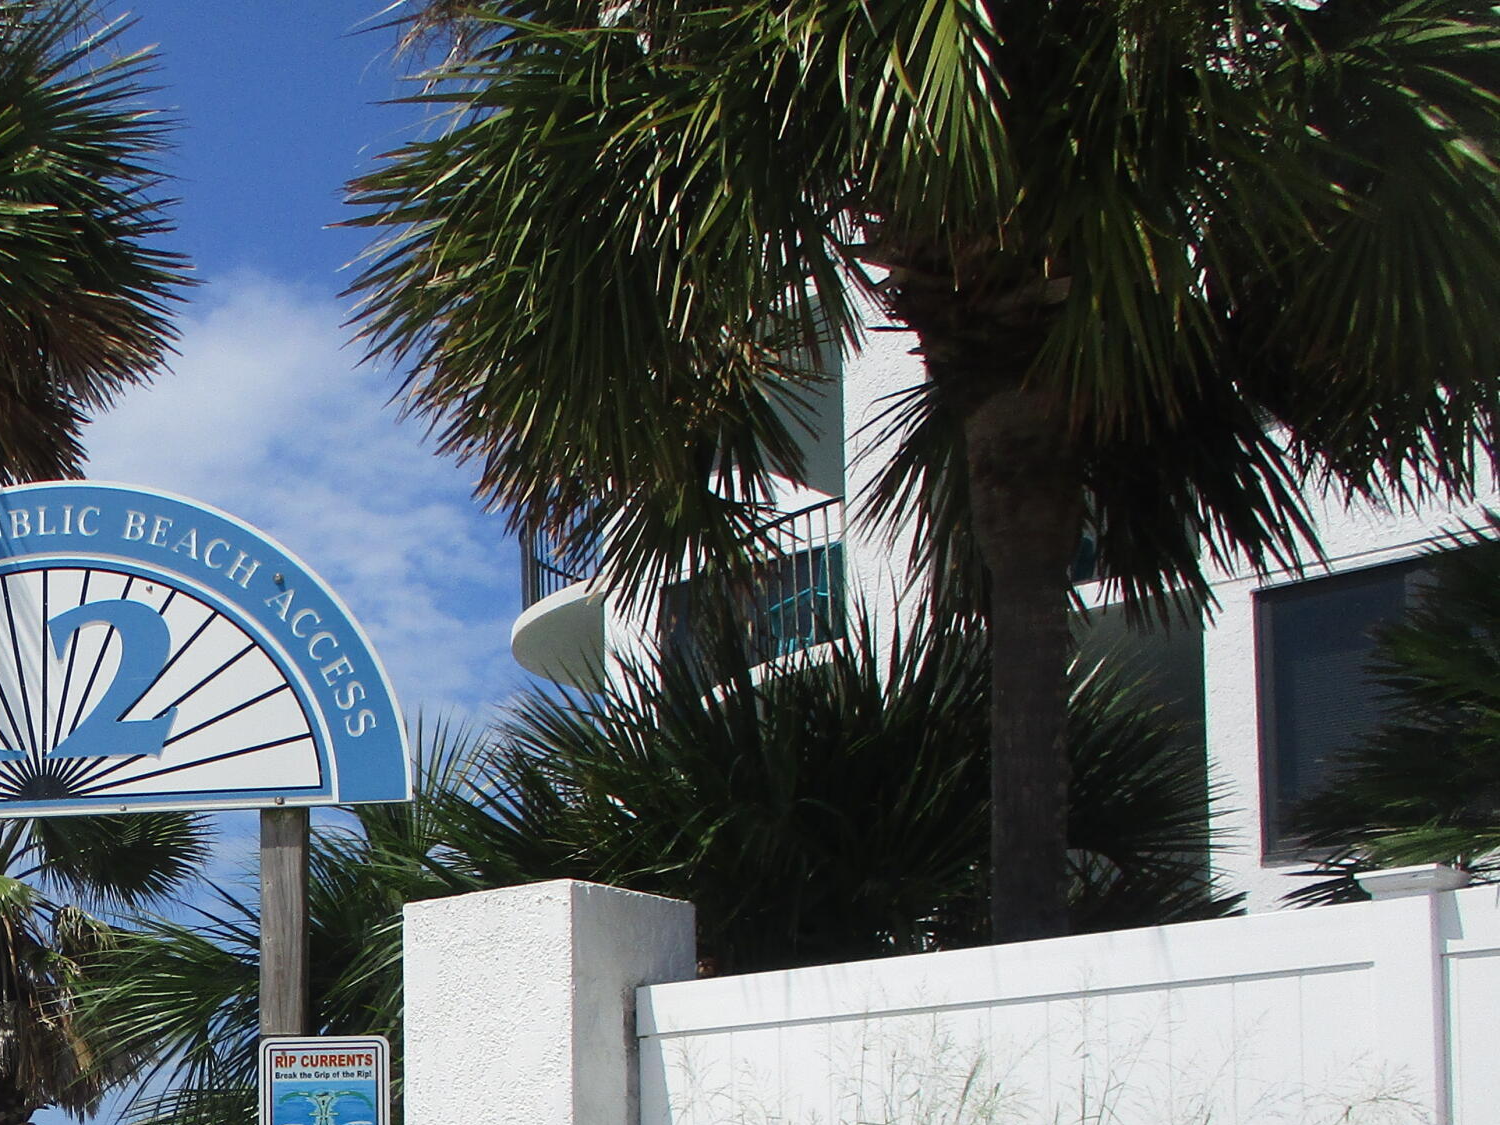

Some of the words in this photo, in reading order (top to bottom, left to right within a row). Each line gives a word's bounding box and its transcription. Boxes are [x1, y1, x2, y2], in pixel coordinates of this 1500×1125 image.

[121, 510, 261, 589] BEACH
[263, 588, 377, 737] ACCESS
[275, 1055, 296, 1068] RIP
[300, 1054, 373, 1067] CURRENTS
[275, 1071, 297, 1079] Break
[300, 1071, 312, 1079] the
[314, 1071, 330, 1080] Grip
[342, 1070, 355, 1078] the
[356, 1070, 372, 1079] Rip!
